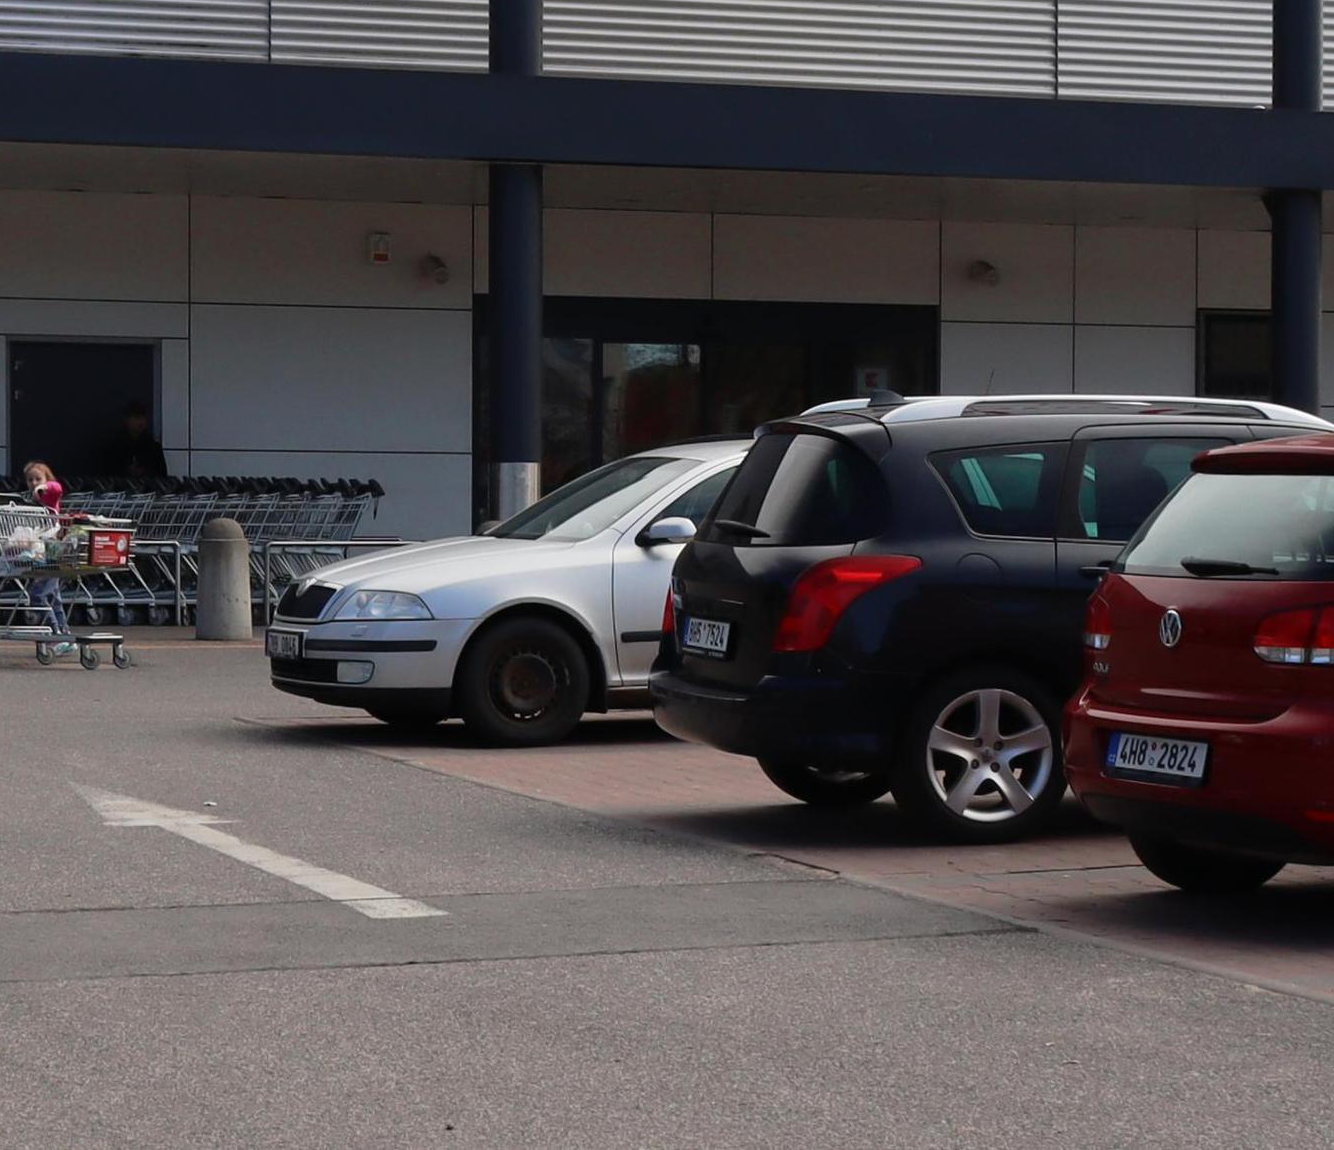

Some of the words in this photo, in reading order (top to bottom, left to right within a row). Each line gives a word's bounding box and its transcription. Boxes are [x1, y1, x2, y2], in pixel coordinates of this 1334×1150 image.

[705, 623, 725, 648] 7524
[1119, 737, 1148, 766] 4H8
[1157, 742, 1198, 773] 2824
